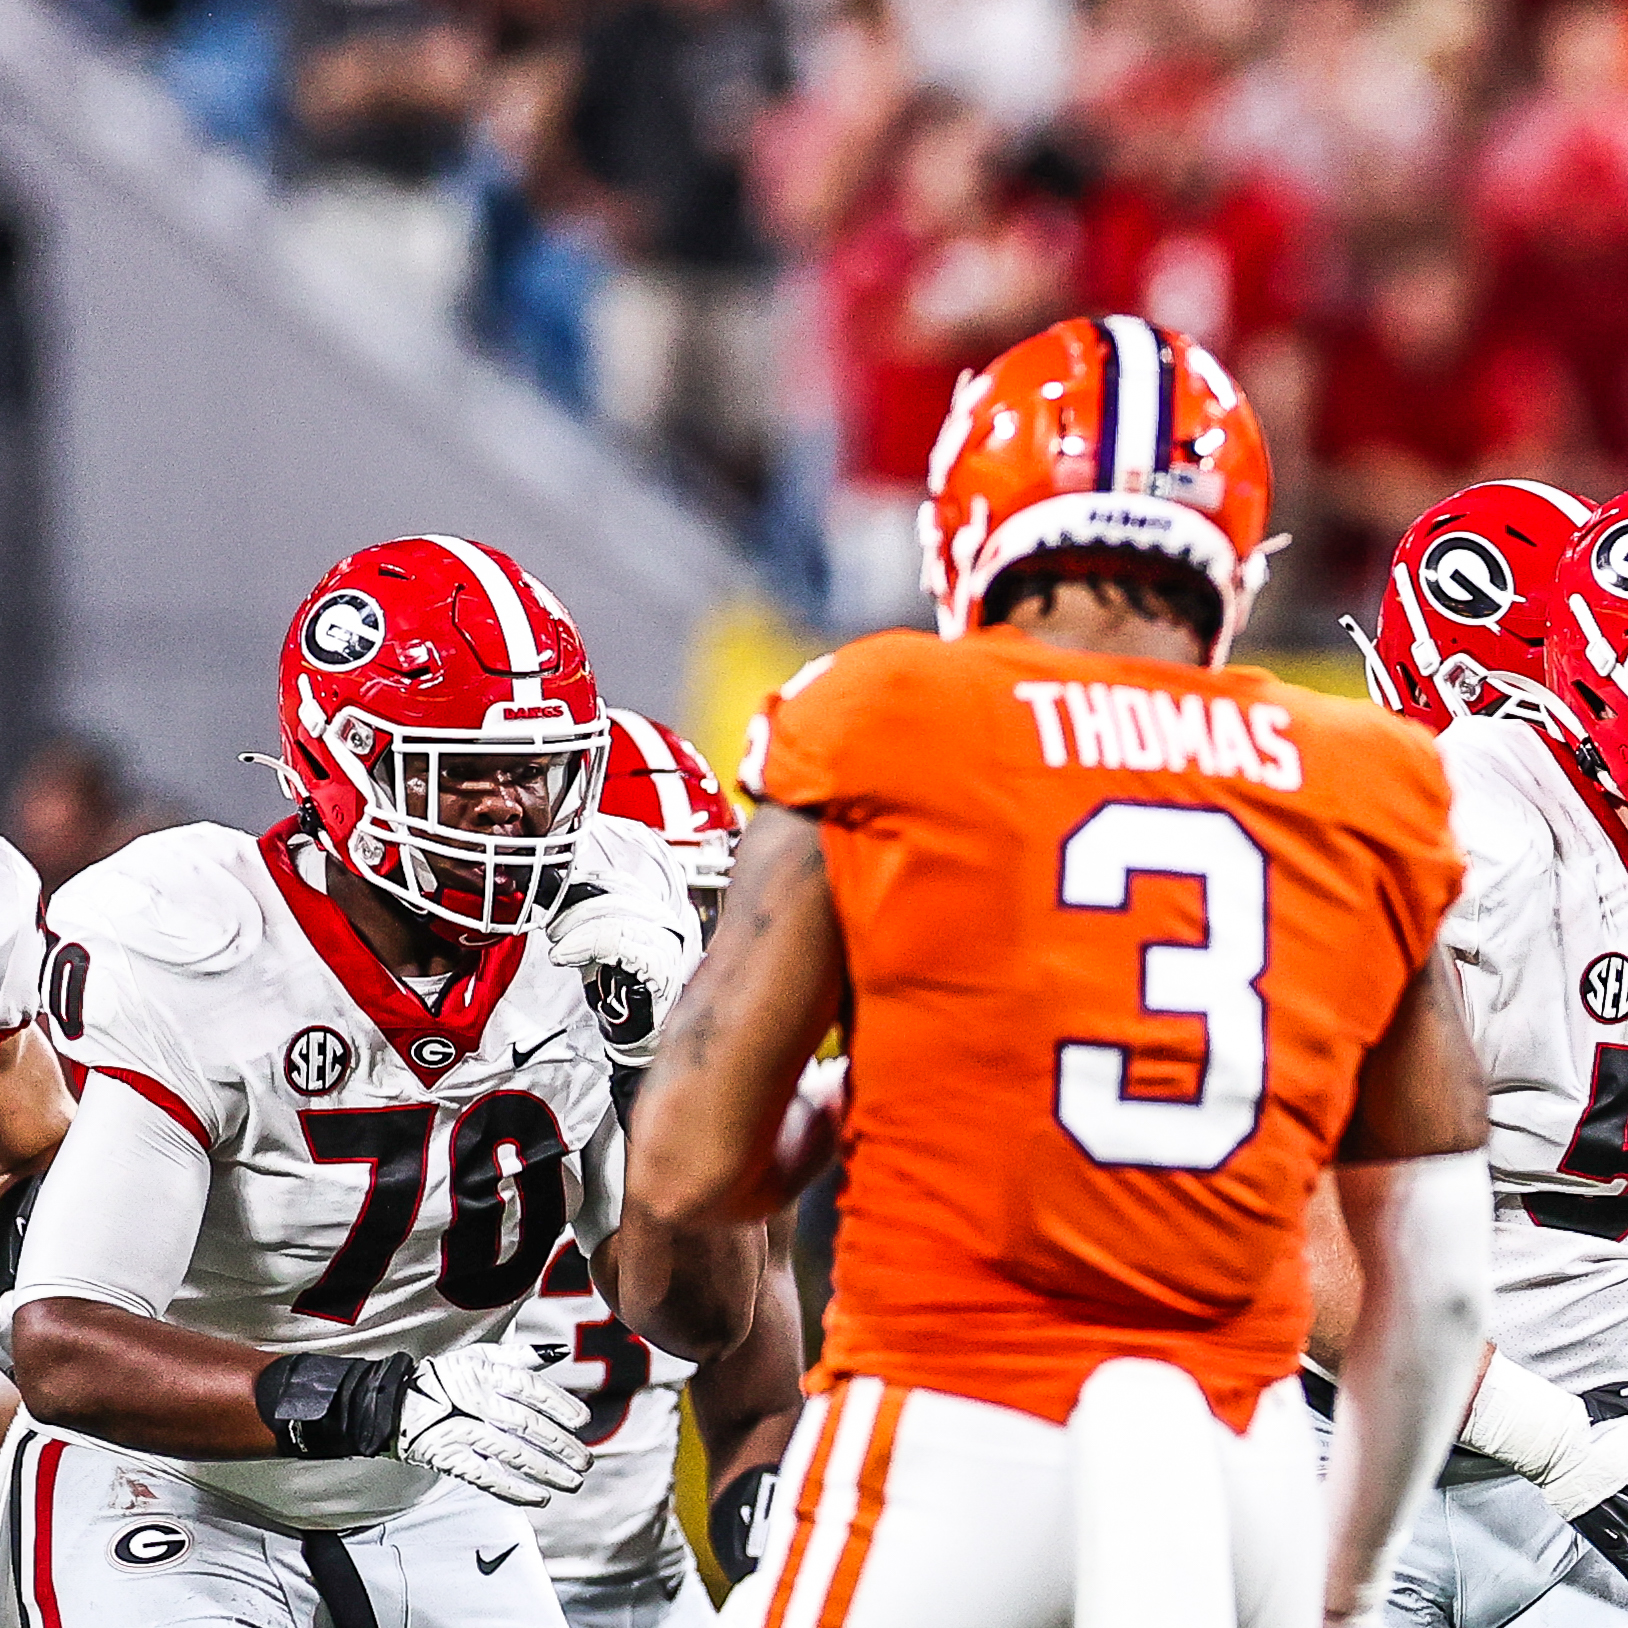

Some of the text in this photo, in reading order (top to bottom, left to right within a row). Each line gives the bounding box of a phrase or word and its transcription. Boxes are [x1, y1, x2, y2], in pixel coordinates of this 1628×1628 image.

[1424, 537, 1511, 621] G
[304, 593, 382, 666] G
[1014, 680, 1302, 792] THOMAS
[1054, 800, 1271, 1172] 3
[289, 1029, 347, 1092] SEC
[412, 1038, 455, 1067] G
[291, 1088, 568, 1327] 70
[112, 1520, 192, 1566] G
